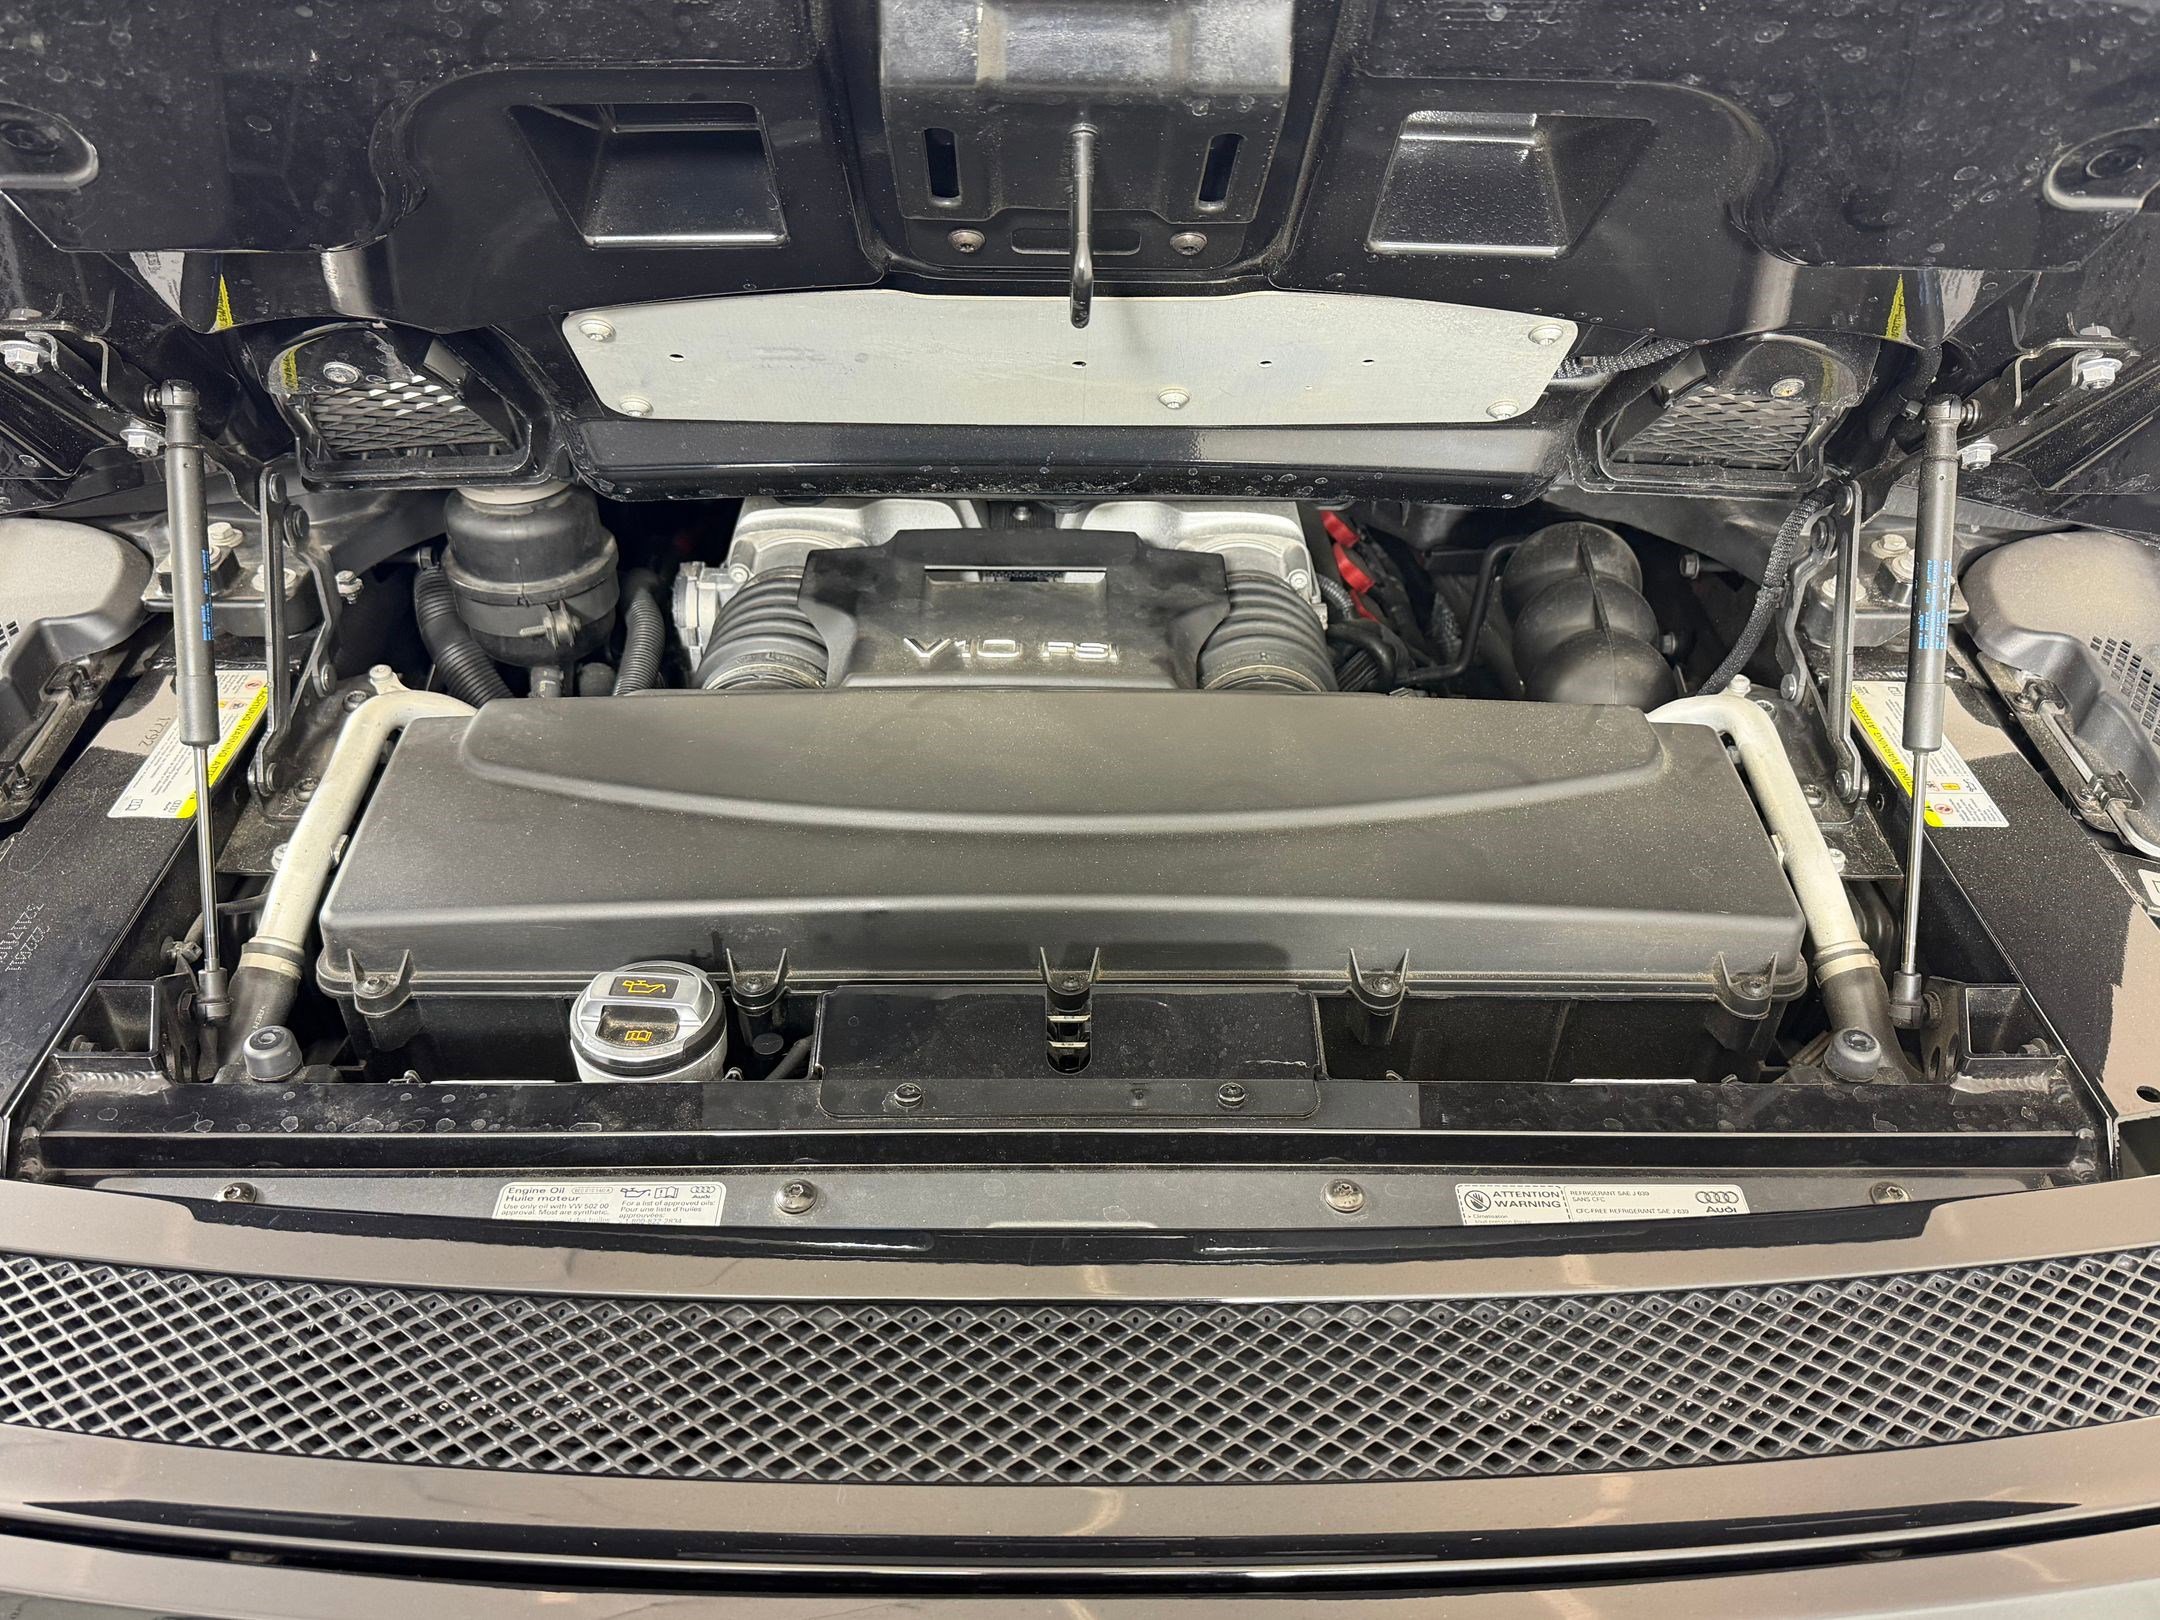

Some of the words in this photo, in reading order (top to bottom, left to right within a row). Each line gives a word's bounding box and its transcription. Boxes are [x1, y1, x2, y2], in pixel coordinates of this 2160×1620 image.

[904, 638, 1023, 660] V10
[1041, 640, 1120, 663] FSI
[138, 717, 171, 747] 17792
[219, 724, 246, 758] WARNING
[508, 1187, 547, 1195] Engine
[520, 1203, 537, 1211] only
[1494, 1200, 1561, 1208] WARNING
[1706, 1205, 1738, 1213] Audi
